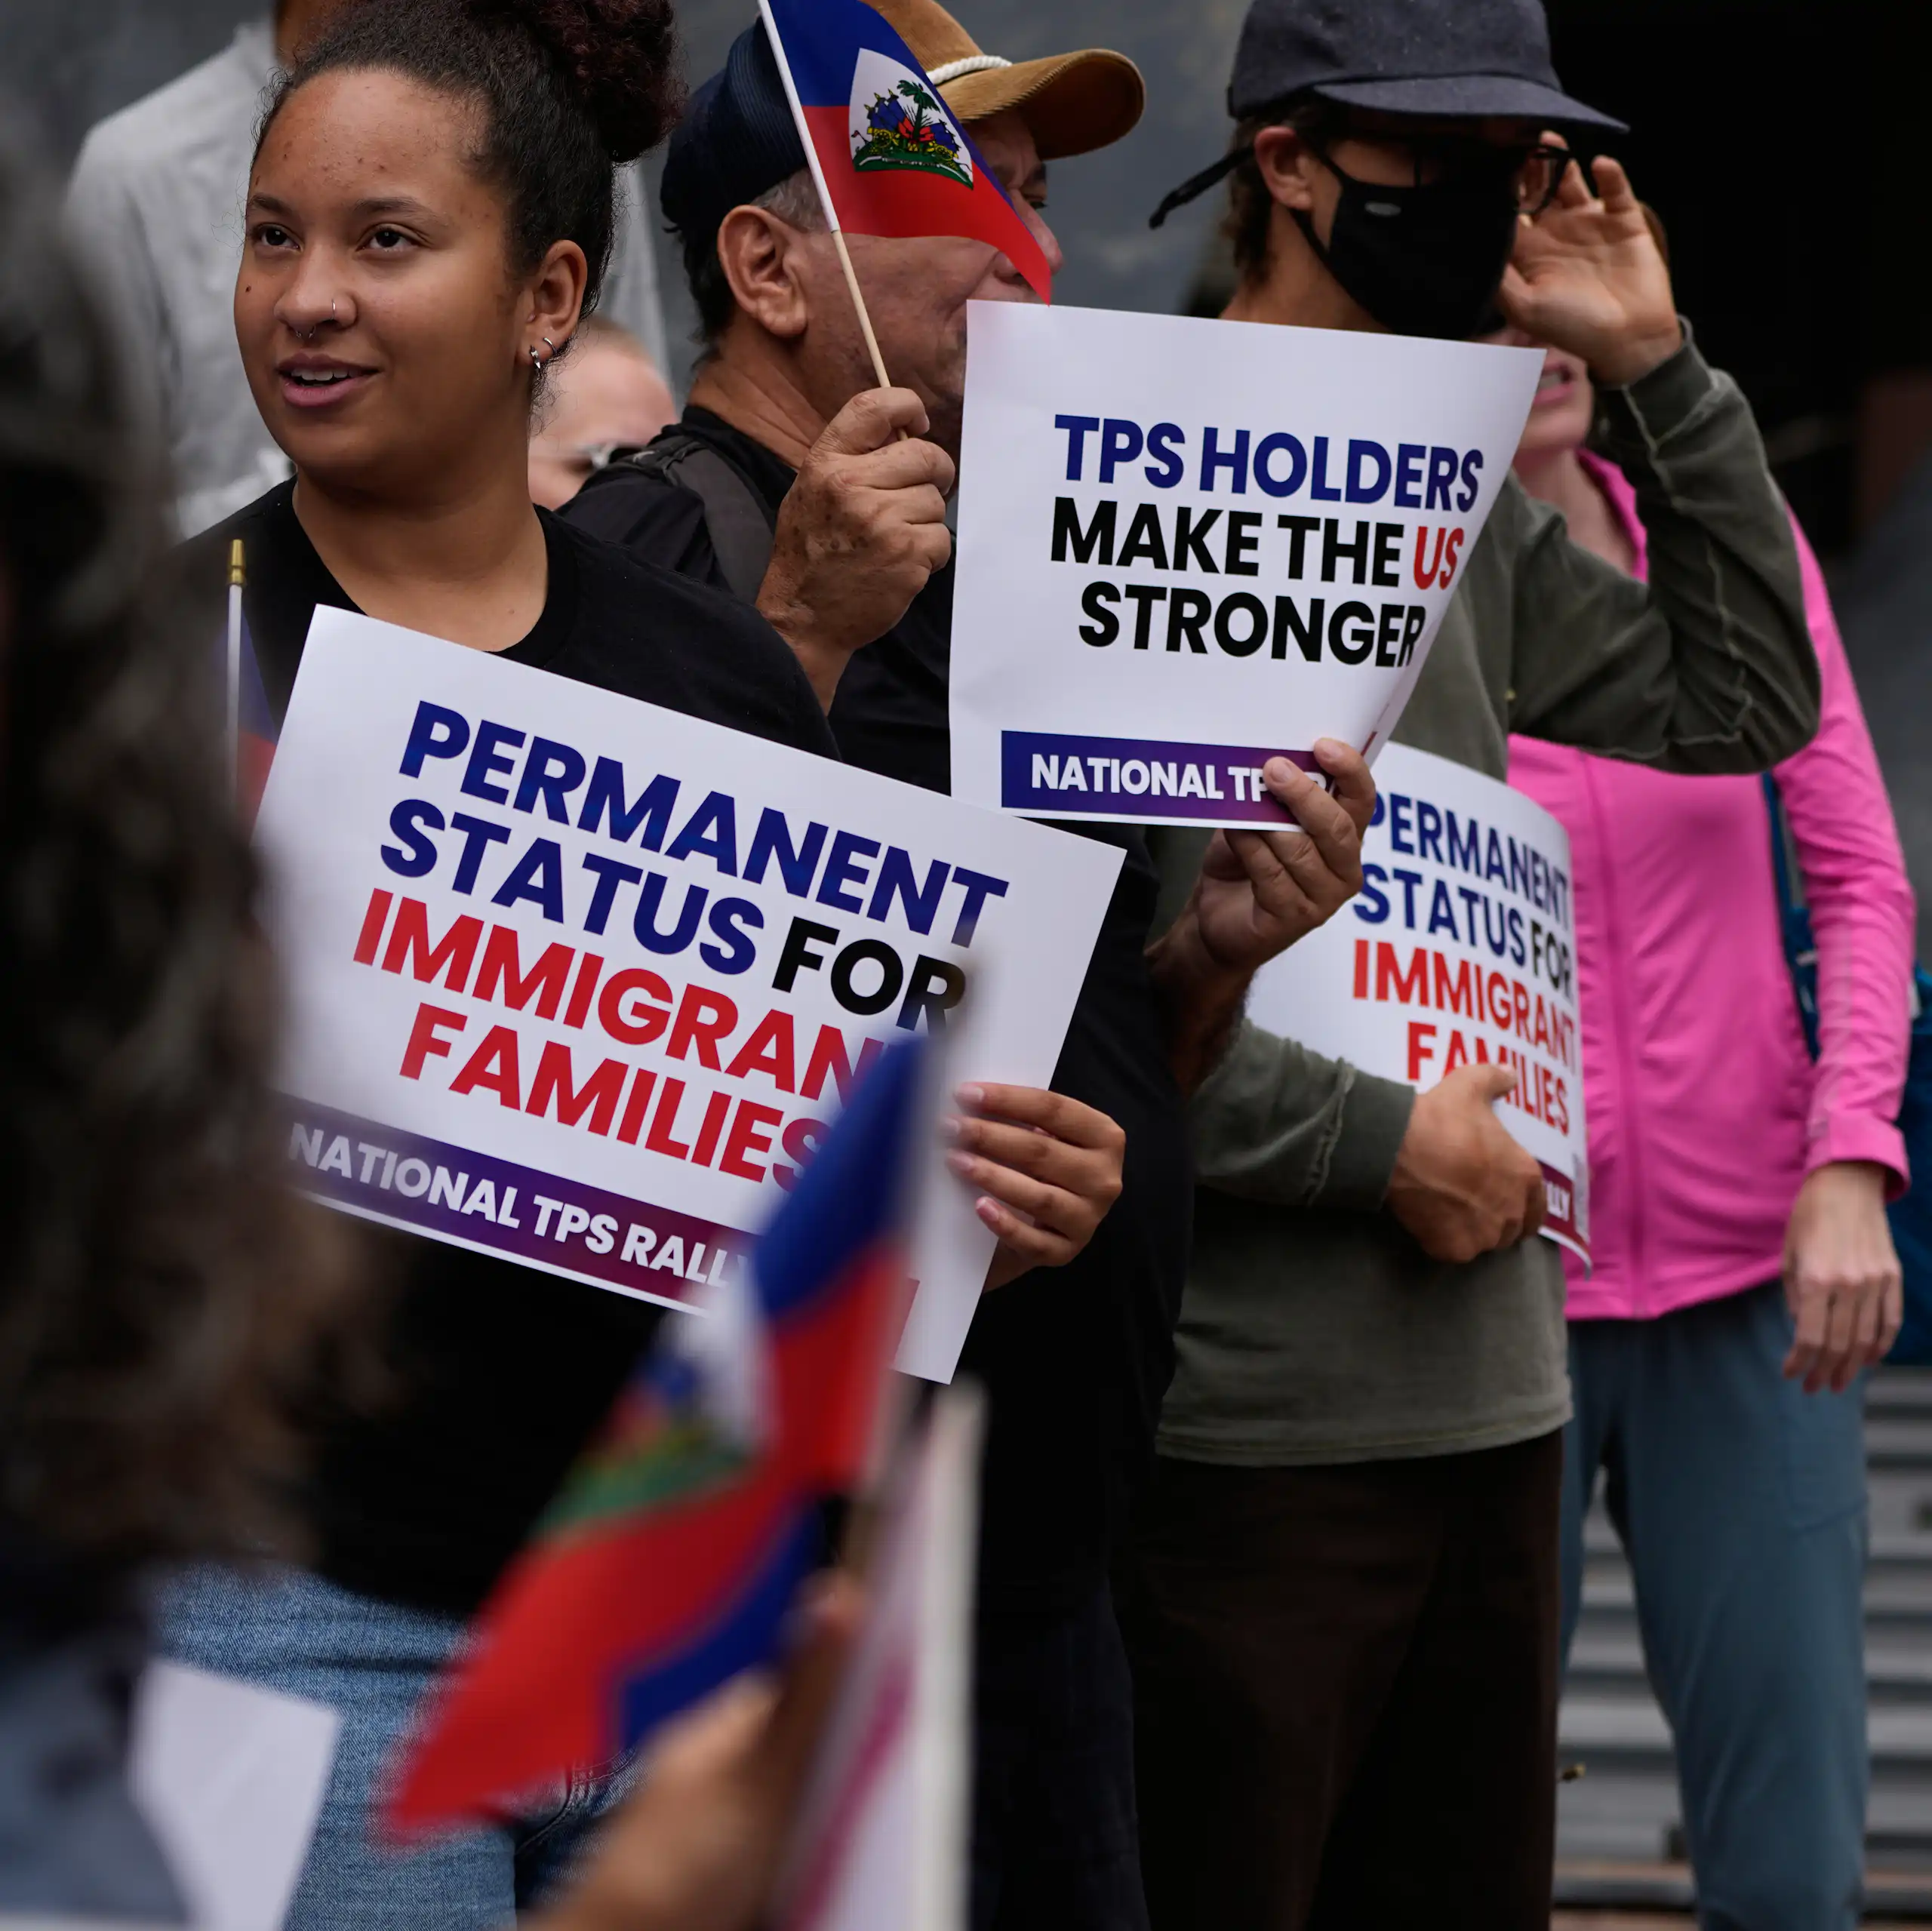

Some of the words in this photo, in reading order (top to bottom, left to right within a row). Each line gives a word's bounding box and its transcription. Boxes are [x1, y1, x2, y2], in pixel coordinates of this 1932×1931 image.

[1054, 414, 1186, 489] TPS
[1199, 426, 1484, 513] HOLDERS
[1051, 496, 1263, 577] MAKE
[1277, 514, 1404, 588] THE
[1413, 525, 1465, 591] US
[1078, 581, 1426, 669] STRONGER
[398, 700, 1010, 949] PERMANENT
[1032, 754, 1224, 800] NATIONAL
[1227, 766, 1269, 802] TP
[380, 798, 764, 976] STATUS
[771, 915, 967, 1036] FOR
[1353, 864, 1526, 968] STATUS
[1531, 918, 1572, 1004] FOR
[352, 887, 895, 1109] IMMIGRAN
[1352, 939, 1575, 1075] IMMIGRANT
[399, 1002, 831, 1194] FAMILIES
[288, 1122, 521, 1229] NATIONAL
[533, 1195, 619, 1254] TPS
